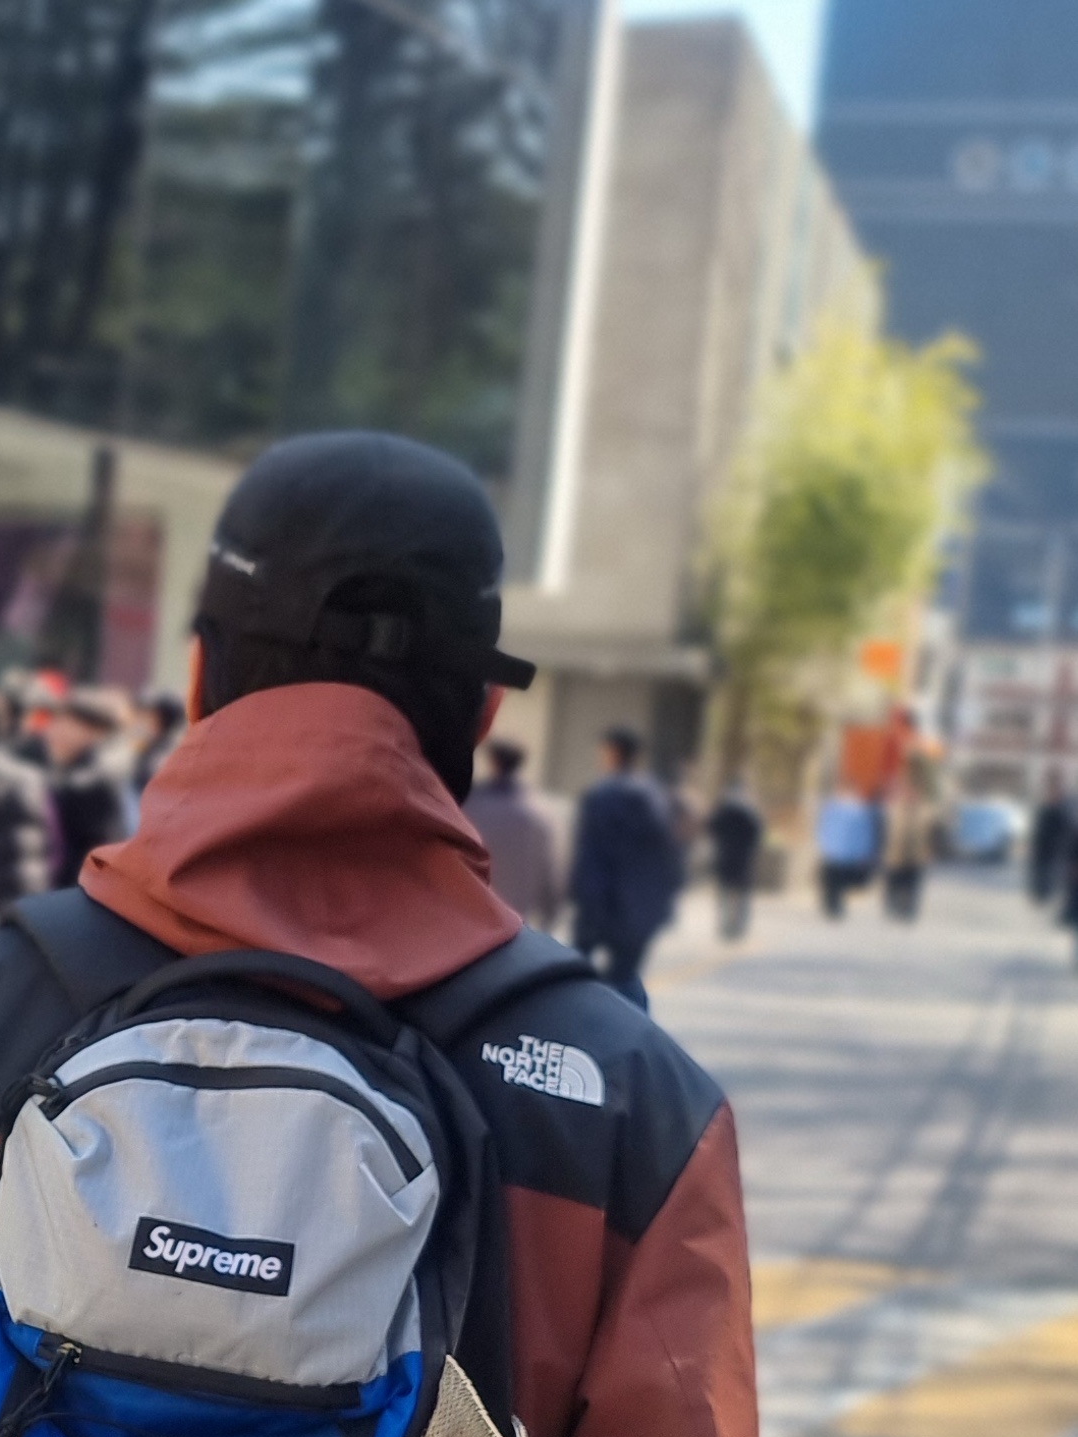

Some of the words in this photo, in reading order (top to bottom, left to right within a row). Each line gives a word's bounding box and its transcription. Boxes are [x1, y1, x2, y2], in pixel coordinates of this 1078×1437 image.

[482, 1042, 562, 1079] NORTH
[518, 1034, 563, 1060] THE
[504, 1065, 561, 1096] FACE
[143, 1226, 282, 1281] Supreme
